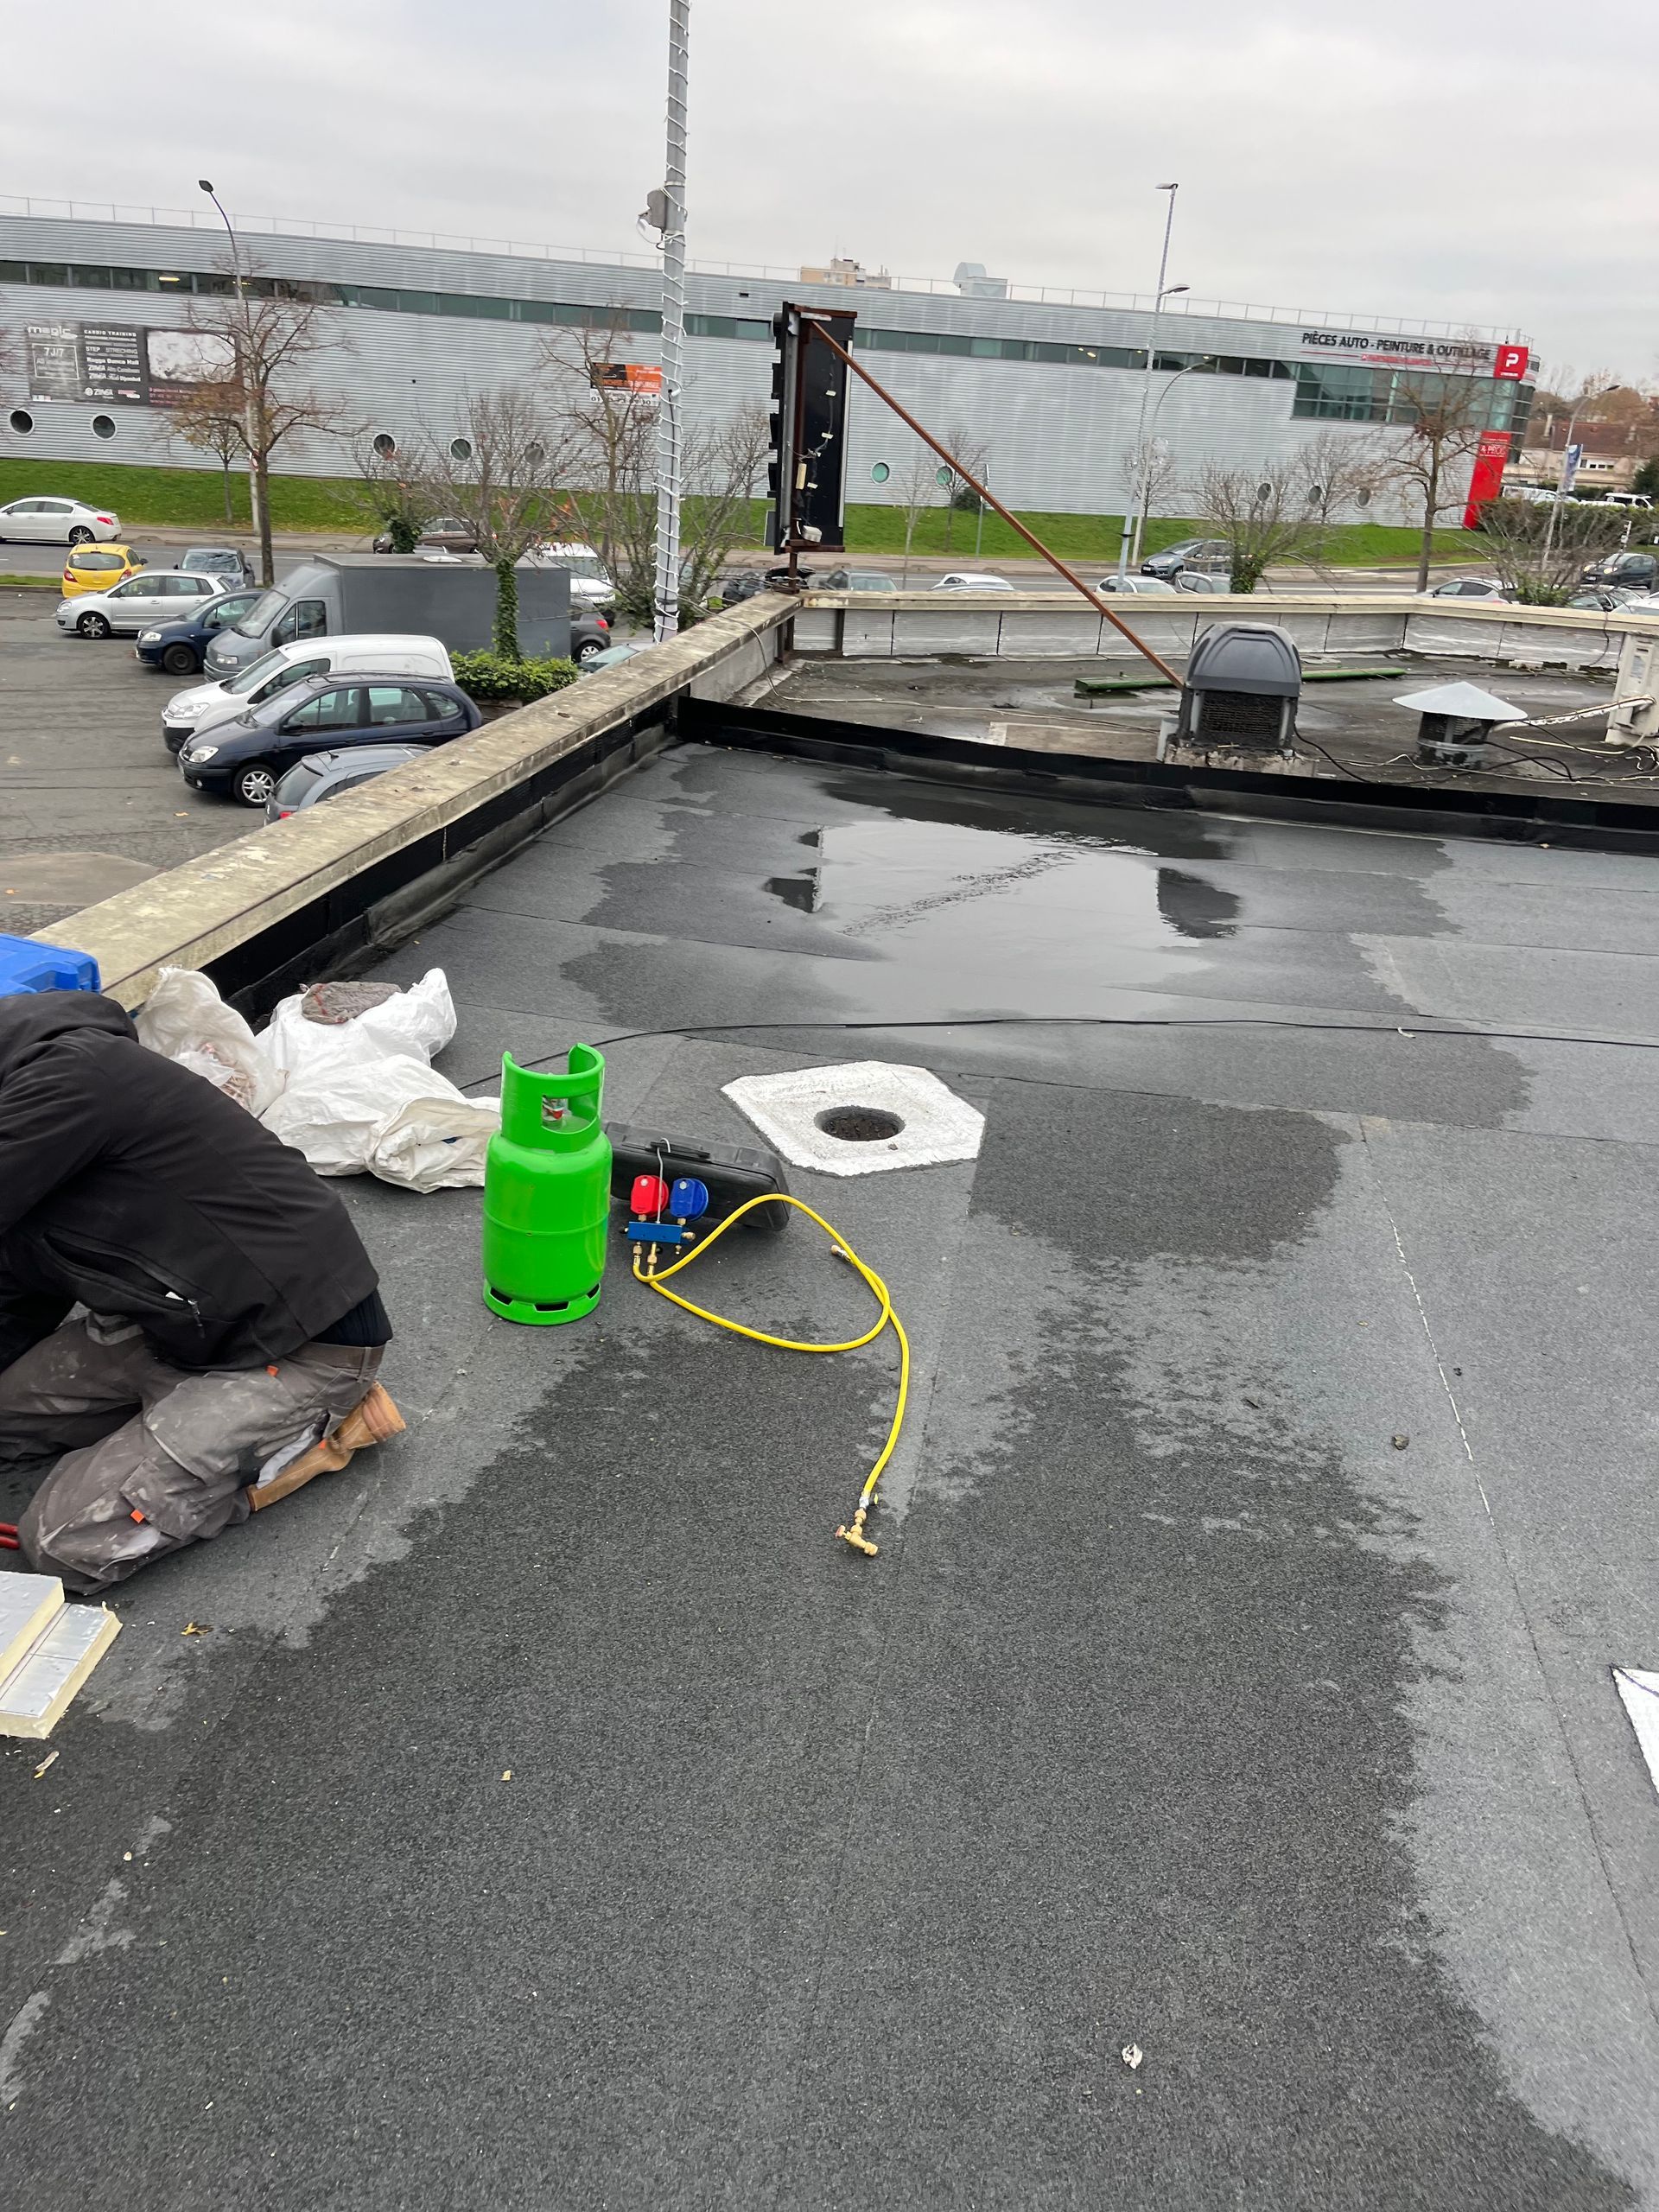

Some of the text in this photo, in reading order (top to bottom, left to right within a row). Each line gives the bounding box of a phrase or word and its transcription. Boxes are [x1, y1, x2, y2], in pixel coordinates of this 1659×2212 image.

[1302, 331, 1338, 346] PIÈCES
[1338, 336, 1369, 349] AUTO
[1376, 339, 1426, 354] PEINTURE
